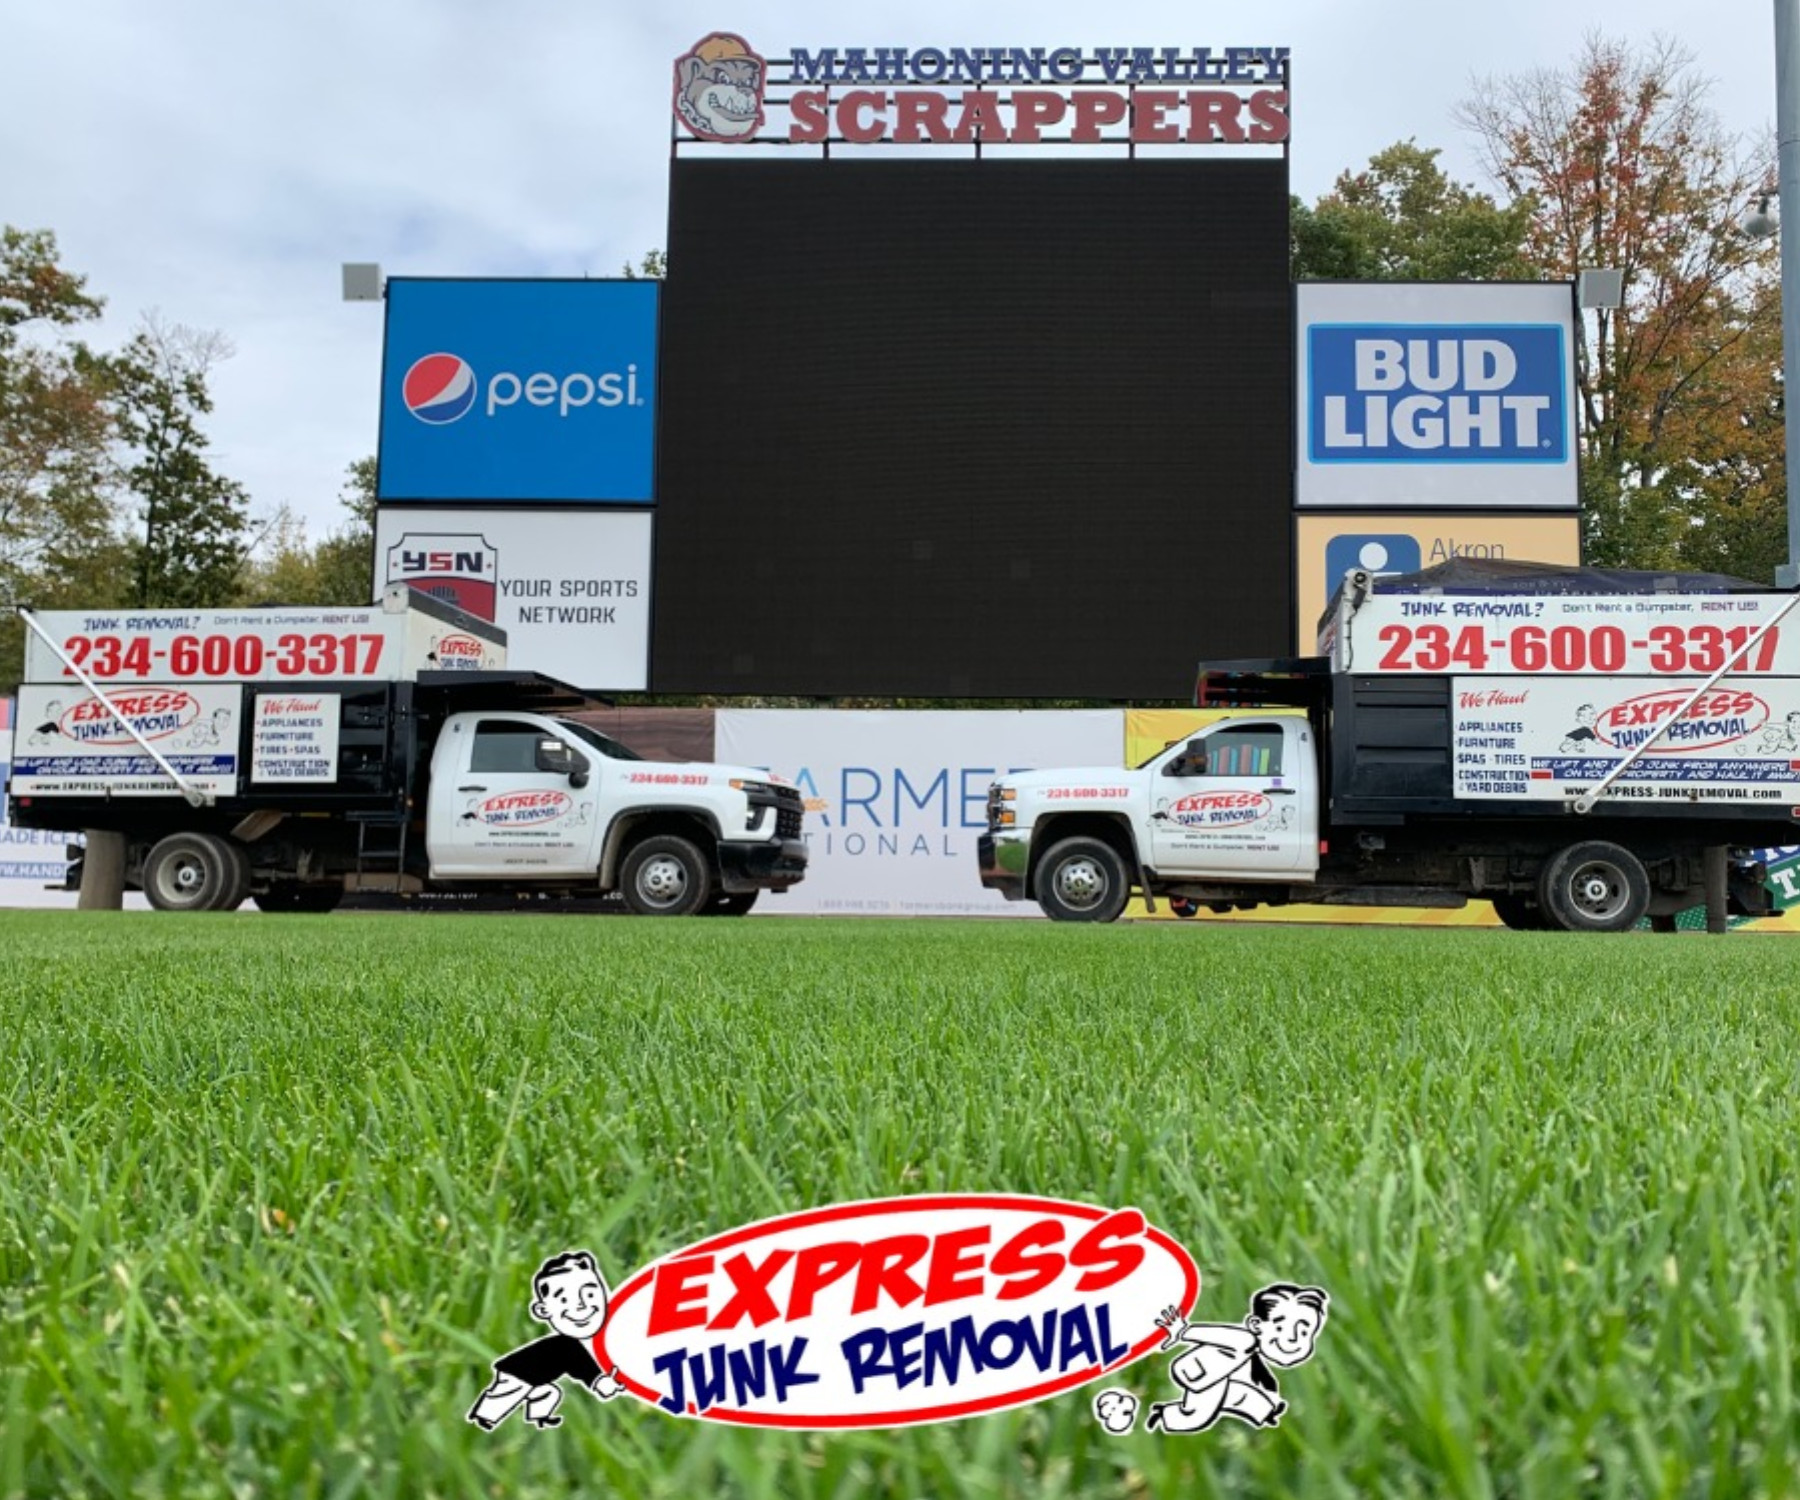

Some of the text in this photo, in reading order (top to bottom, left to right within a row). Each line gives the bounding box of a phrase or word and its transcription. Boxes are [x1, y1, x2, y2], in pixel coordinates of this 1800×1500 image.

[789, 47, 1290, 84] MAHONING VALLEY
[789, 89, 1290, 144] SCRAPPERS
[1355, 339, 1517, 392] BUD
[486, 363, 638, 417] pepsi
[1324, 394, 1550, 449] LIGHT
[1429, 538, 1504, 561] Akron
[403, 551, 483, 572] YSN
[500, 580, 638, 597] YOUR SPORTS
[1401, 602, 1544, 617] JUNK REMOVAL?
[1562, 603, 1591, 613] Don't
[1595, 603, 1622, 612] Rent
[1701, 602, 1734, 611] RENT
[322, 615, 349, 624] RENT
[519, 607, 616, 624] NETWORK
[84, 616, 201, 631] JUNK REMOVAL?
[62, 633, 385, 677] 234-600-3317
[1378, 624, 1780, 672] 234-600-3317
[1459, 689, 1530, 708] We Haul
[261, 718, 323, 727] APPLIANCES
[1458, 722, 1523, 733] APPLIANCES
[1668, 718, 1750, 741] REMOVAL
[72, 725, 113, 741] JUNK
[260, 732, 313, 741] FURNITURE
[1458, 738, 1516, 749] FURNITURE
[163, 757, 215, 766] NYWHERE
[258, 760, 330, 768] CONSTRUCTION
[1458, 754, 1526, 765] SPAS TIRES
[1583, 760, 1608, 769] AND
[1611, 761, 1644, 769] LAD
[1683, 761, 1718, 770] FROM
[267, 768, 293, 777] YARD
[1458, 770, 1530, 780] CONSTRUCTION
[1585, 769, 1612, 778] YOU
[1047, 788, 1130, 799] 234-600-3317
[1465, 783, 1492, 793] YARD
[1493, 783, 1528, 793] DEBRIS
[484, 792, 564, 812] EXPRESS
[752, 767, 1036, 828] ARME
[1177, 794, 1263, 812] EXPRESS
[0, 831, 37, 844] ADE
[0, 864, 67, 876] W.HAND
